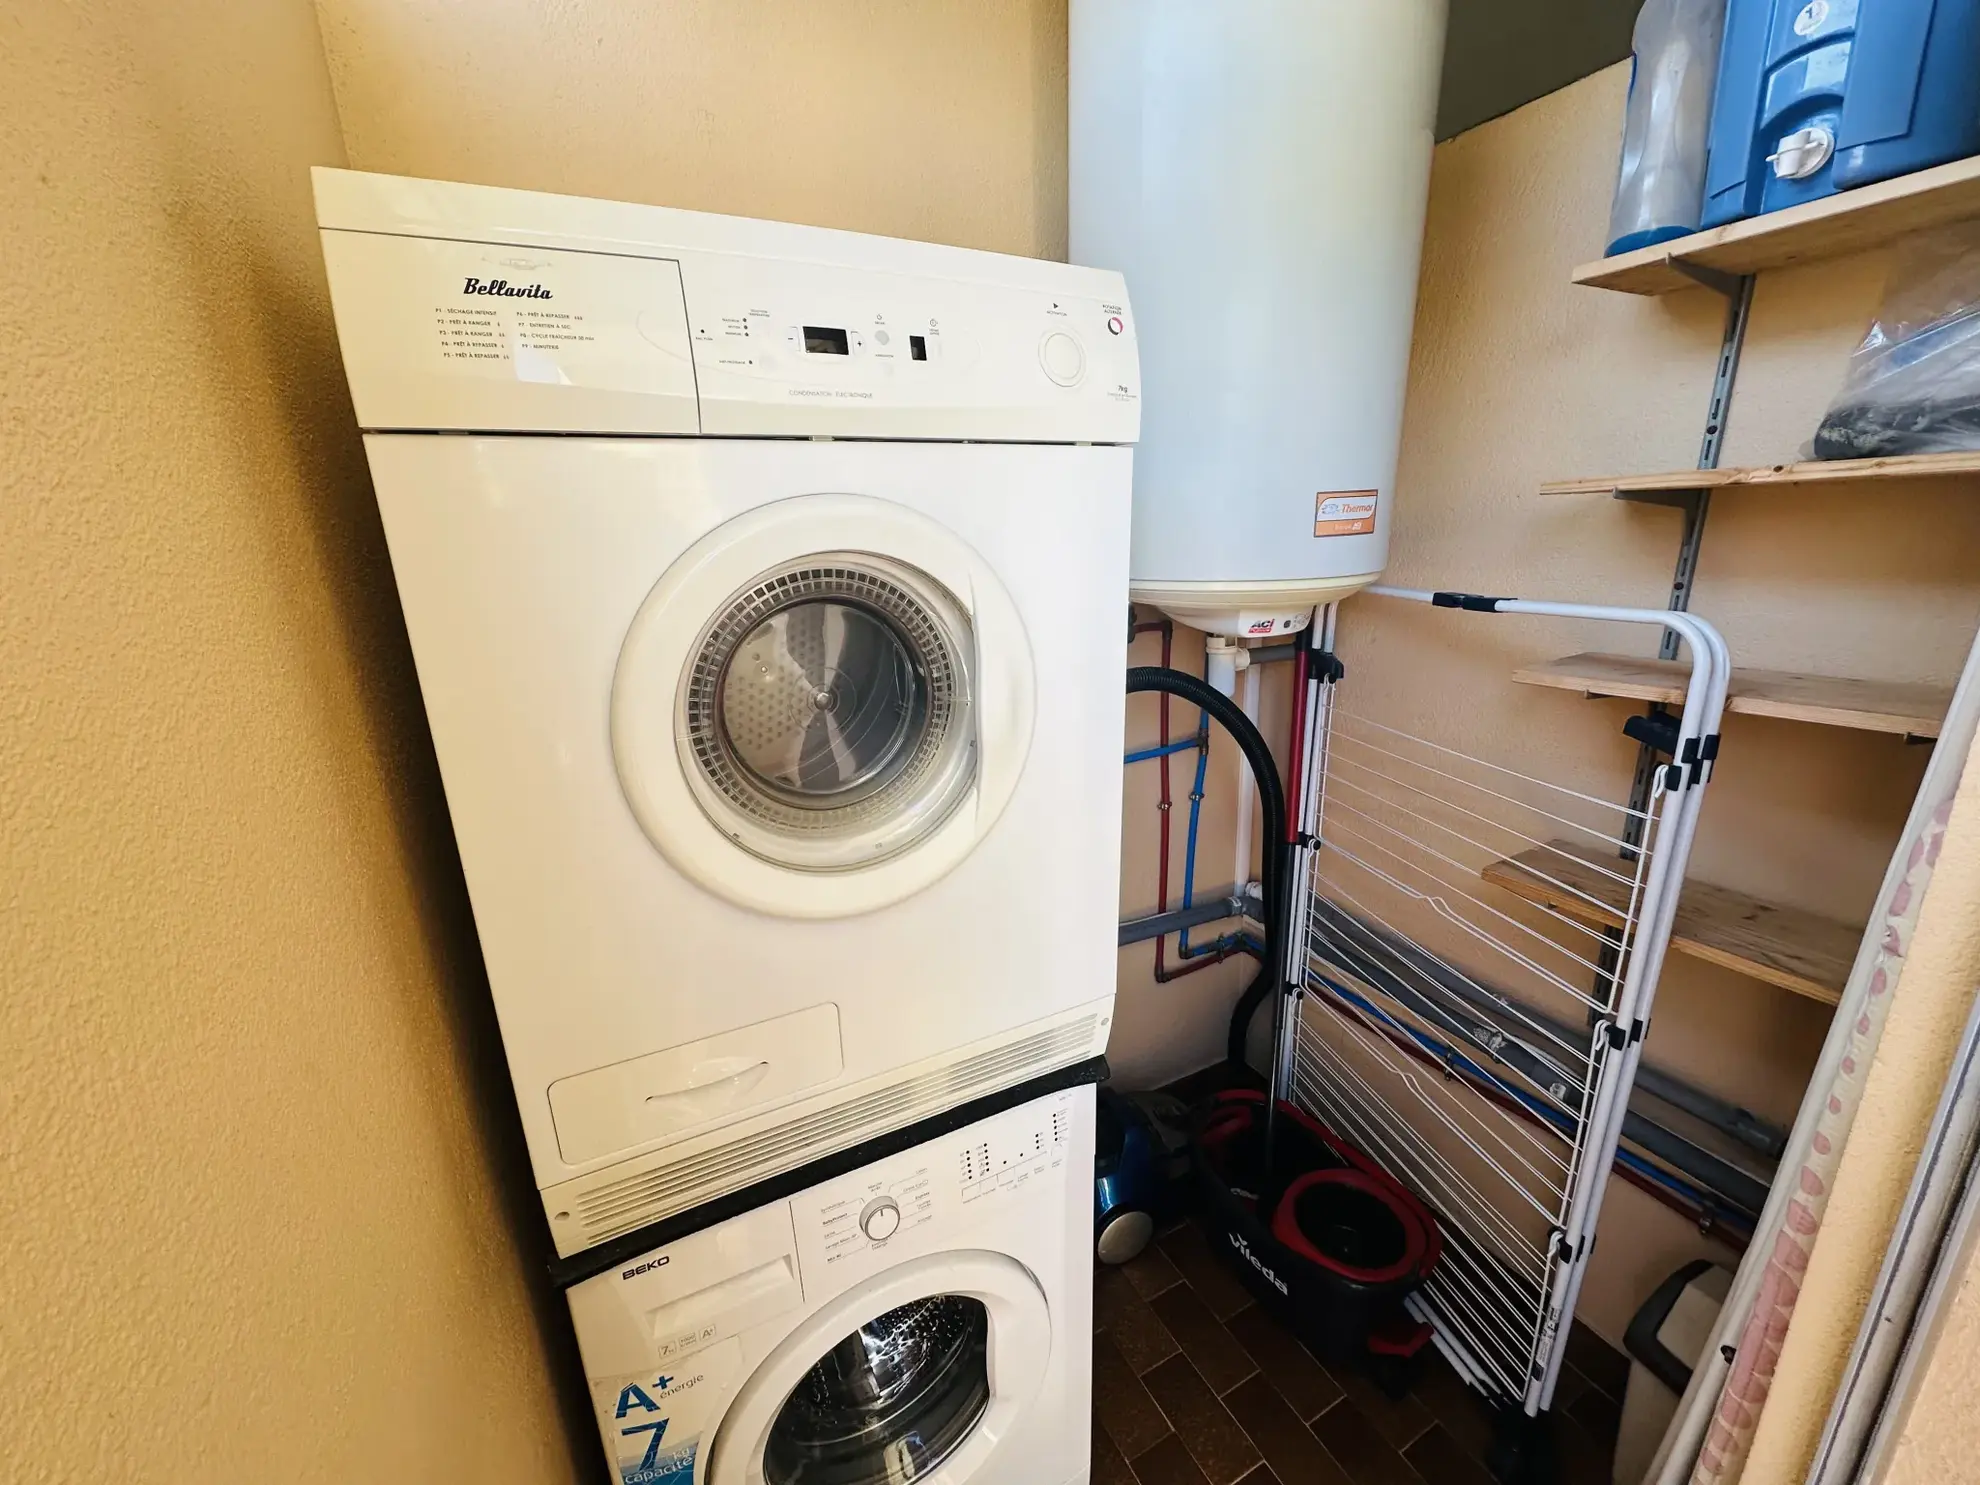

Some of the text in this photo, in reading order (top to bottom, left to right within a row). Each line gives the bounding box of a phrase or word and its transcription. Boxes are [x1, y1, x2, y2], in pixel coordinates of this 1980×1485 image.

[463, 277, 553, 300] Bellavita
[1341, 503, 1374, 514] Thermor
[622, 1255, 670, 1281] BEKO
[1228, 1232, 1288, 1296] vileda
[615, 1375, 675, 1419] A+
[659, 1374, 704, 1400] énergie
[621, 1417, 670, 1471] 7
[672, 1447, 690, 1461] kg
